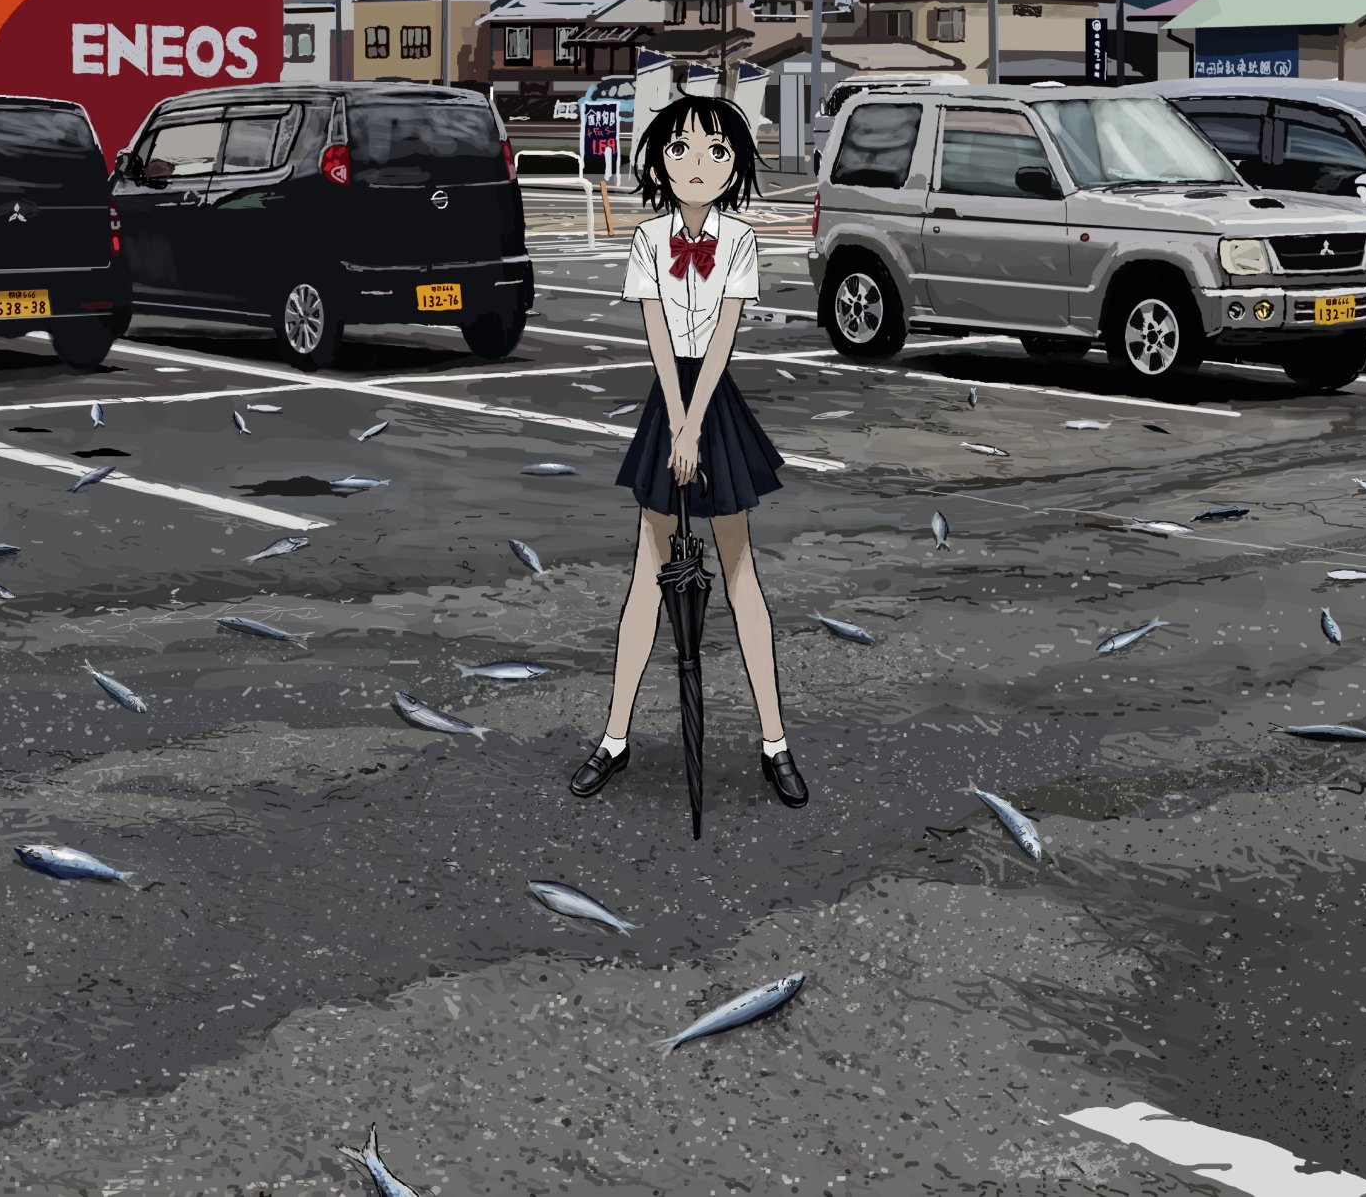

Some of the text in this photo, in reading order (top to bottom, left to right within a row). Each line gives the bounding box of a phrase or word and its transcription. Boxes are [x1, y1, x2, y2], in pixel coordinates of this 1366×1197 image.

[72, 23, 258, 78] ENEOS
[423, 294, 459, 308] 132-76
[1319, 307, 1355, 321] 132-17
